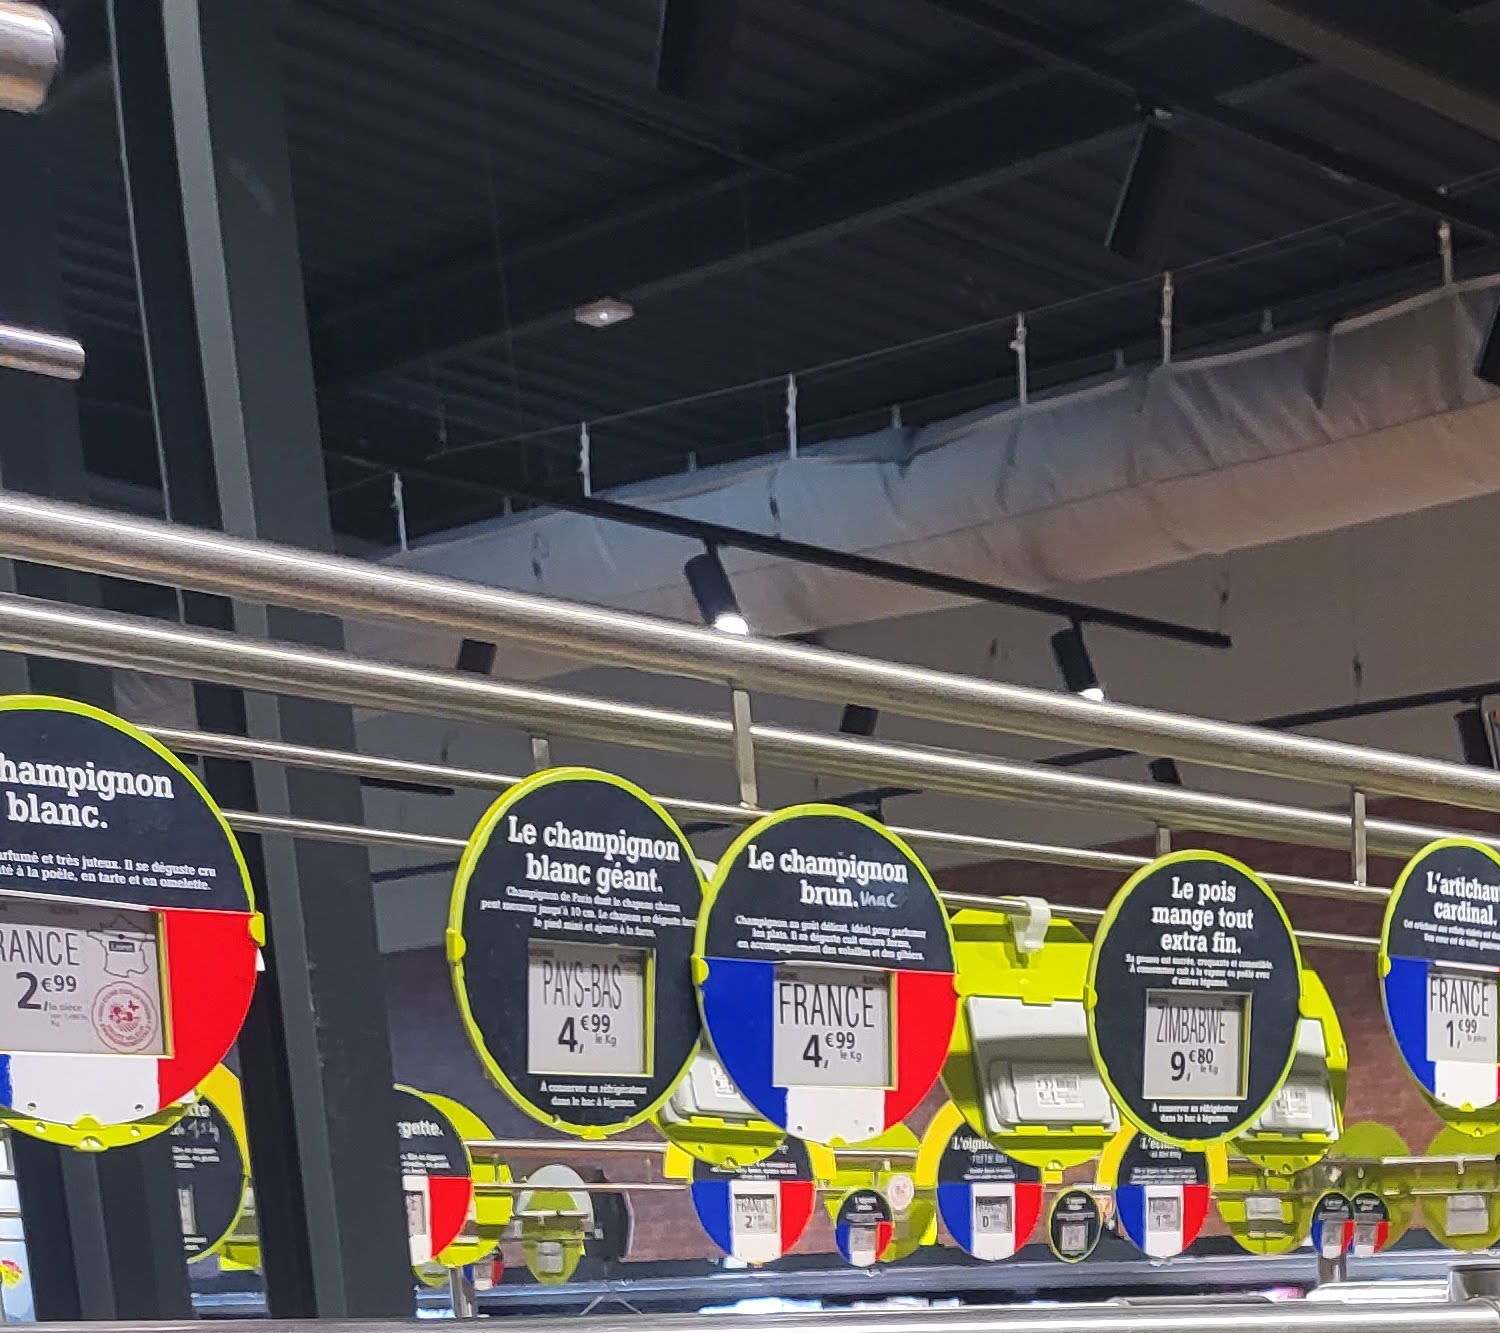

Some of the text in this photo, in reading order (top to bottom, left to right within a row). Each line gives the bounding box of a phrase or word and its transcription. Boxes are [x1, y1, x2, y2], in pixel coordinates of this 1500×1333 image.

[6, 791, 108, 829] blanc.
[508, 815, 680, 863] Le champignon
[16, 866, 24, 876] à
[27, 866, 38, 878] la
[81, 872, 96, 882] en
[99, 872, 126, 885] tarte
[128, 874, 140, 885] et
[142, 877, 157, 887] en
[42, 853, 54, 864] et
[56, 853, 79, 867] très
[124, 859, 133, 870] Il
[136, 861, 149, 872] se
[151, 861, 195, 877] déguste
[197, 866, 216, 877] cru
[525, 853, 663, 894] blanc géant.
[748, 844, 908, 886] Le champignon
[800, 879, 859, 908] brun.
[1171, 876, 1236, 906] Le pois
[1151, 906, 1254, 932] mange tout
[1434, 901, 1498, 926] cardinal.
[1160, 931, 1242, 954] extra fin.
[542, 960, 622, 1010] PAYS-BAS
[1430, 976, 1489, 1017] FRANCE
[779, 983, 875, 1028] FRANCE
[1156, 1005, 1226, 1045] ZIMBABWE
